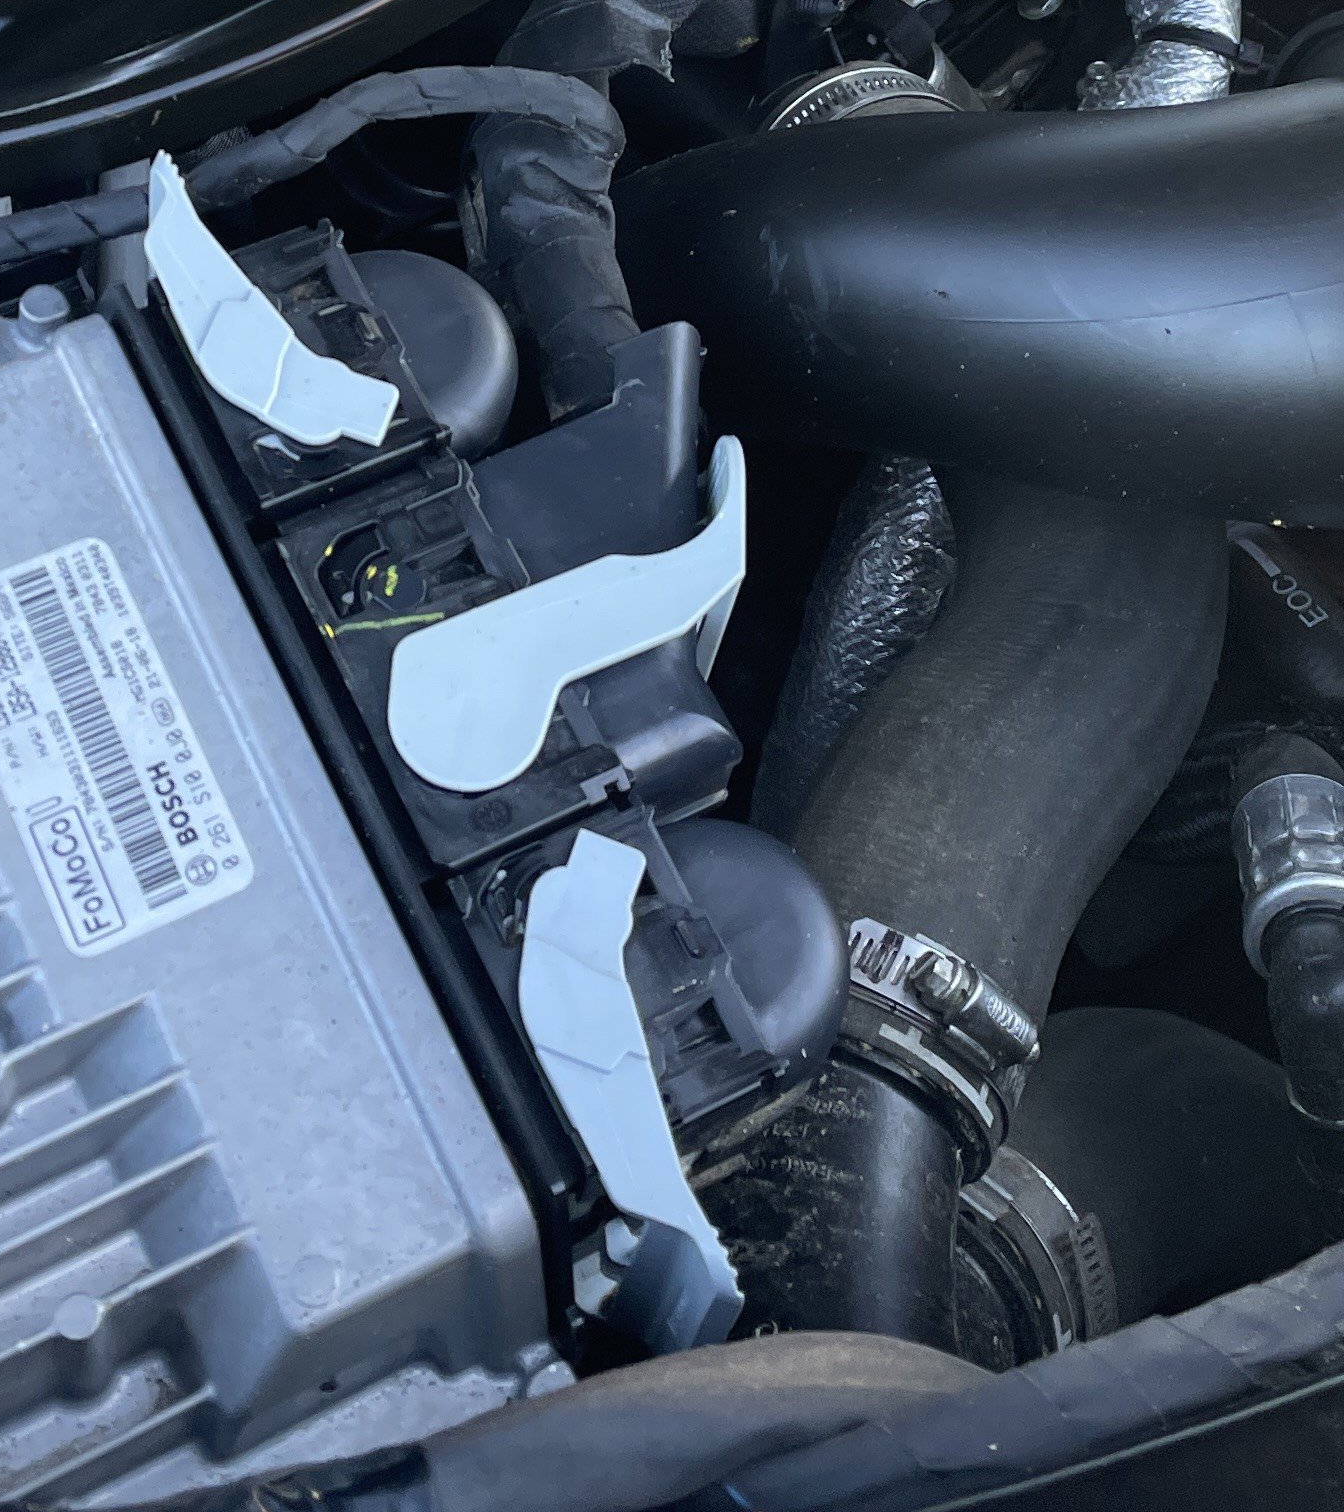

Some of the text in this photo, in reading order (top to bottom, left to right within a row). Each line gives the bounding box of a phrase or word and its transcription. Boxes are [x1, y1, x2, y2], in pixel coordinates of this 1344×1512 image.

[145, 759, 199, 848] BOSCH
[202, 812, 231, 848] 261
[41, 815, 113, 936] FoMoCo
